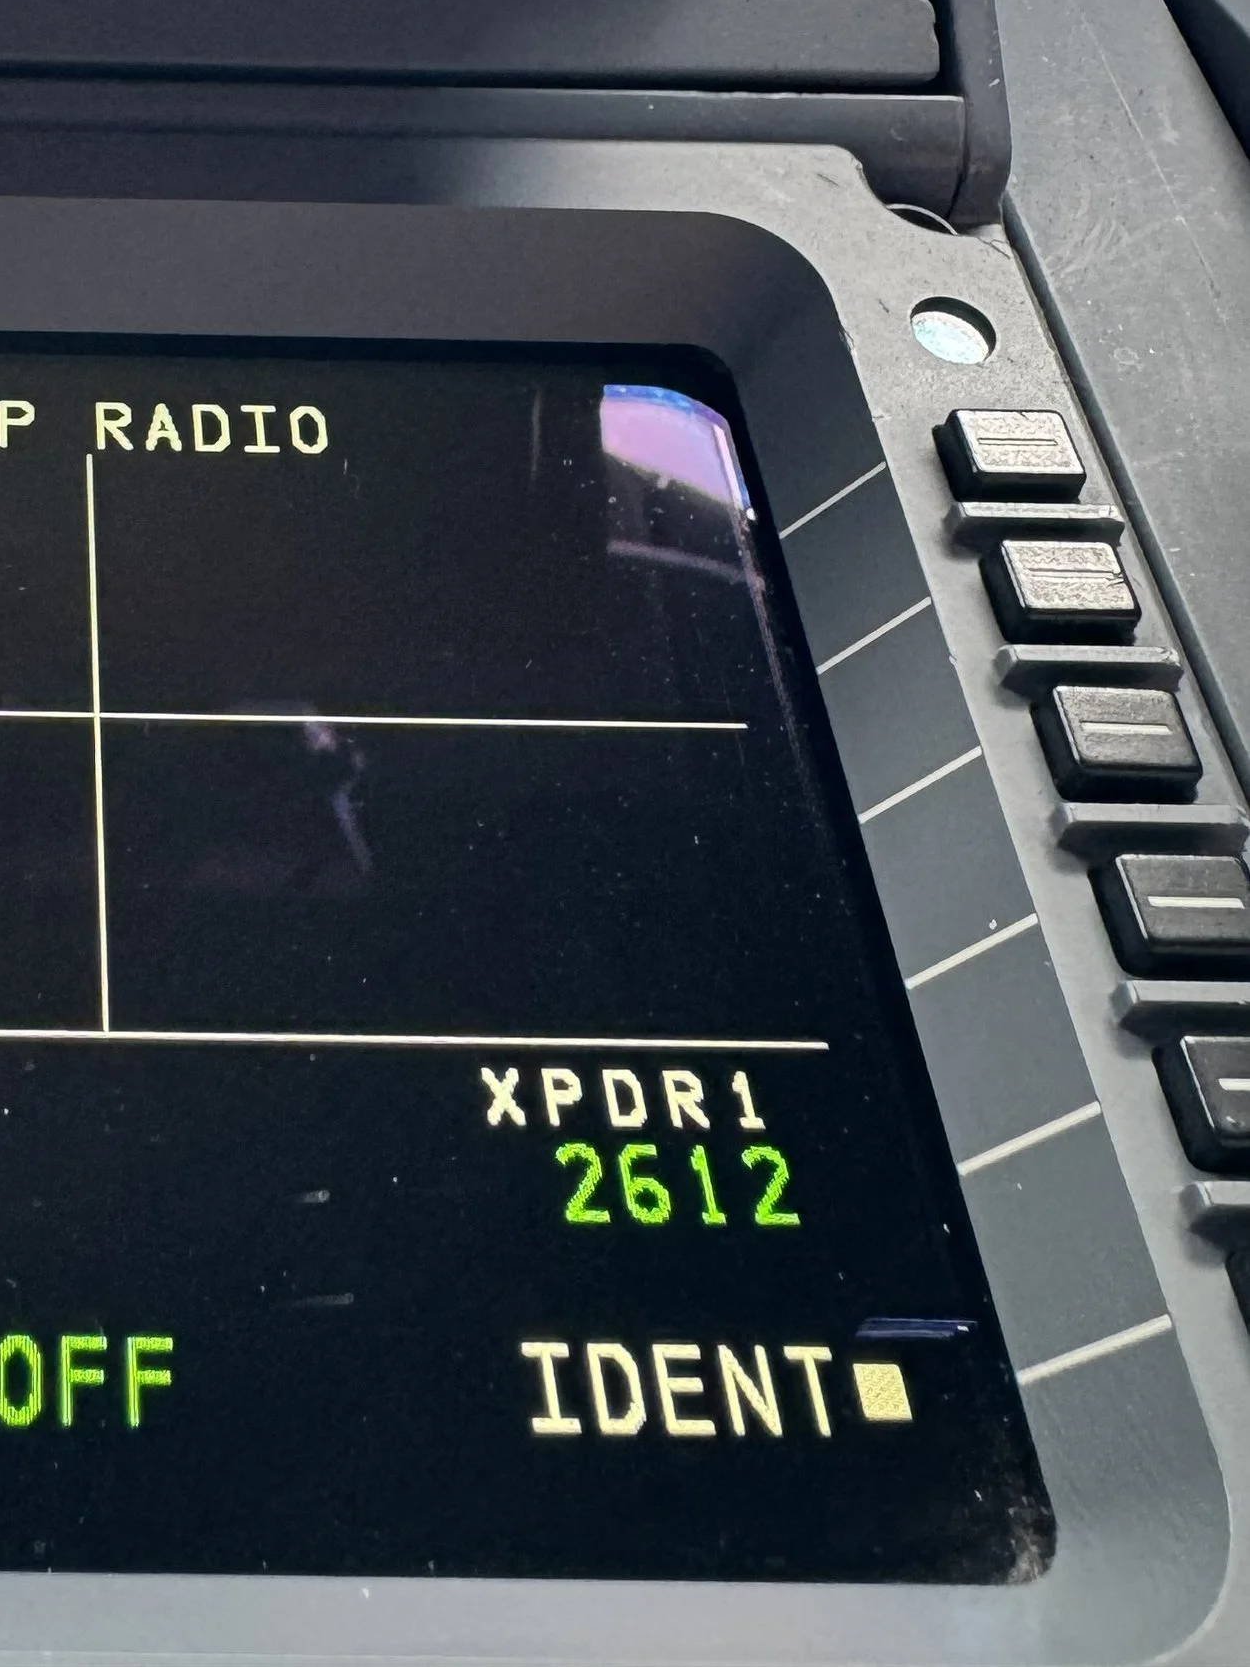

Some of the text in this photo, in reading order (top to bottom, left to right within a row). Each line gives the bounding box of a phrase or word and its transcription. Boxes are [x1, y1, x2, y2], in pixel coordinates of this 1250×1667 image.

[94, 401, 330, 455] RADIO
[480, 1066, 767, 1131] XPDR1
[553, 1142, 802, 1228] 2612
[520, 1341, 834, 1439] IDENT
